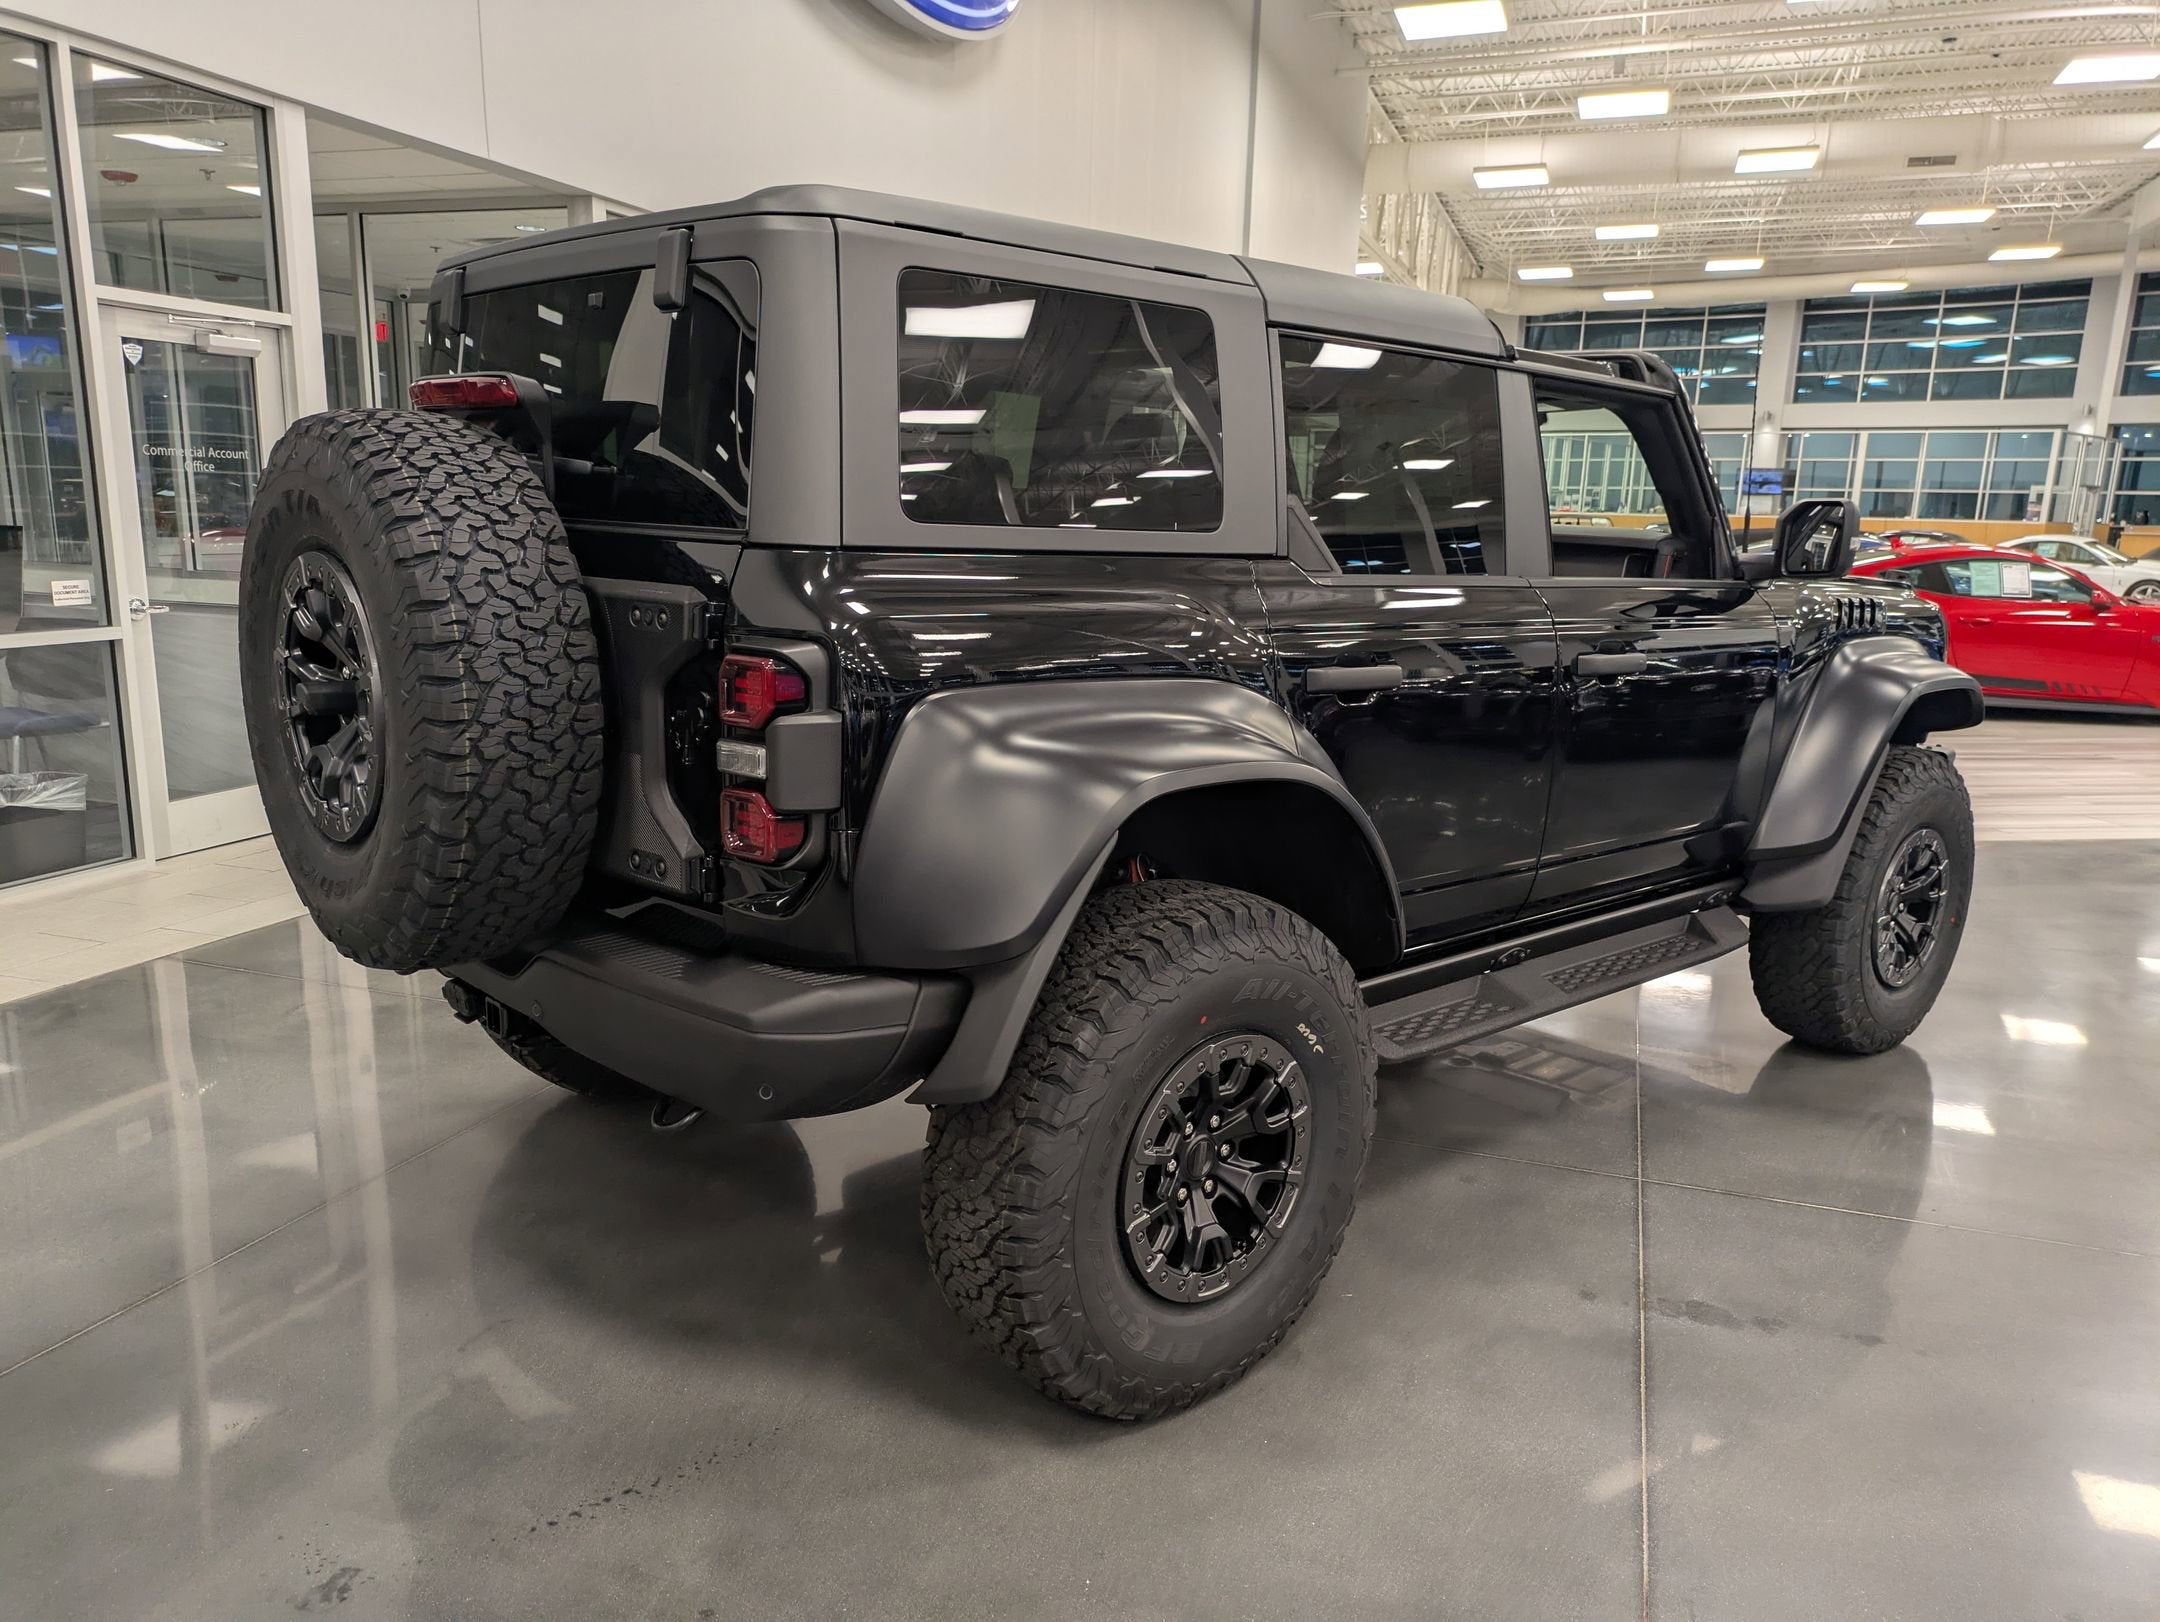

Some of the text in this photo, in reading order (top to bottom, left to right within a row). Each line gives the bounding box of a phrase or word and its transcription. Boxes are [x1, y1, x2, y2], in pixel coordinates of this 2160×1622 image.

[142, 444, 249, 460] Commercial Account
[184, 460, 216, 472] Office
